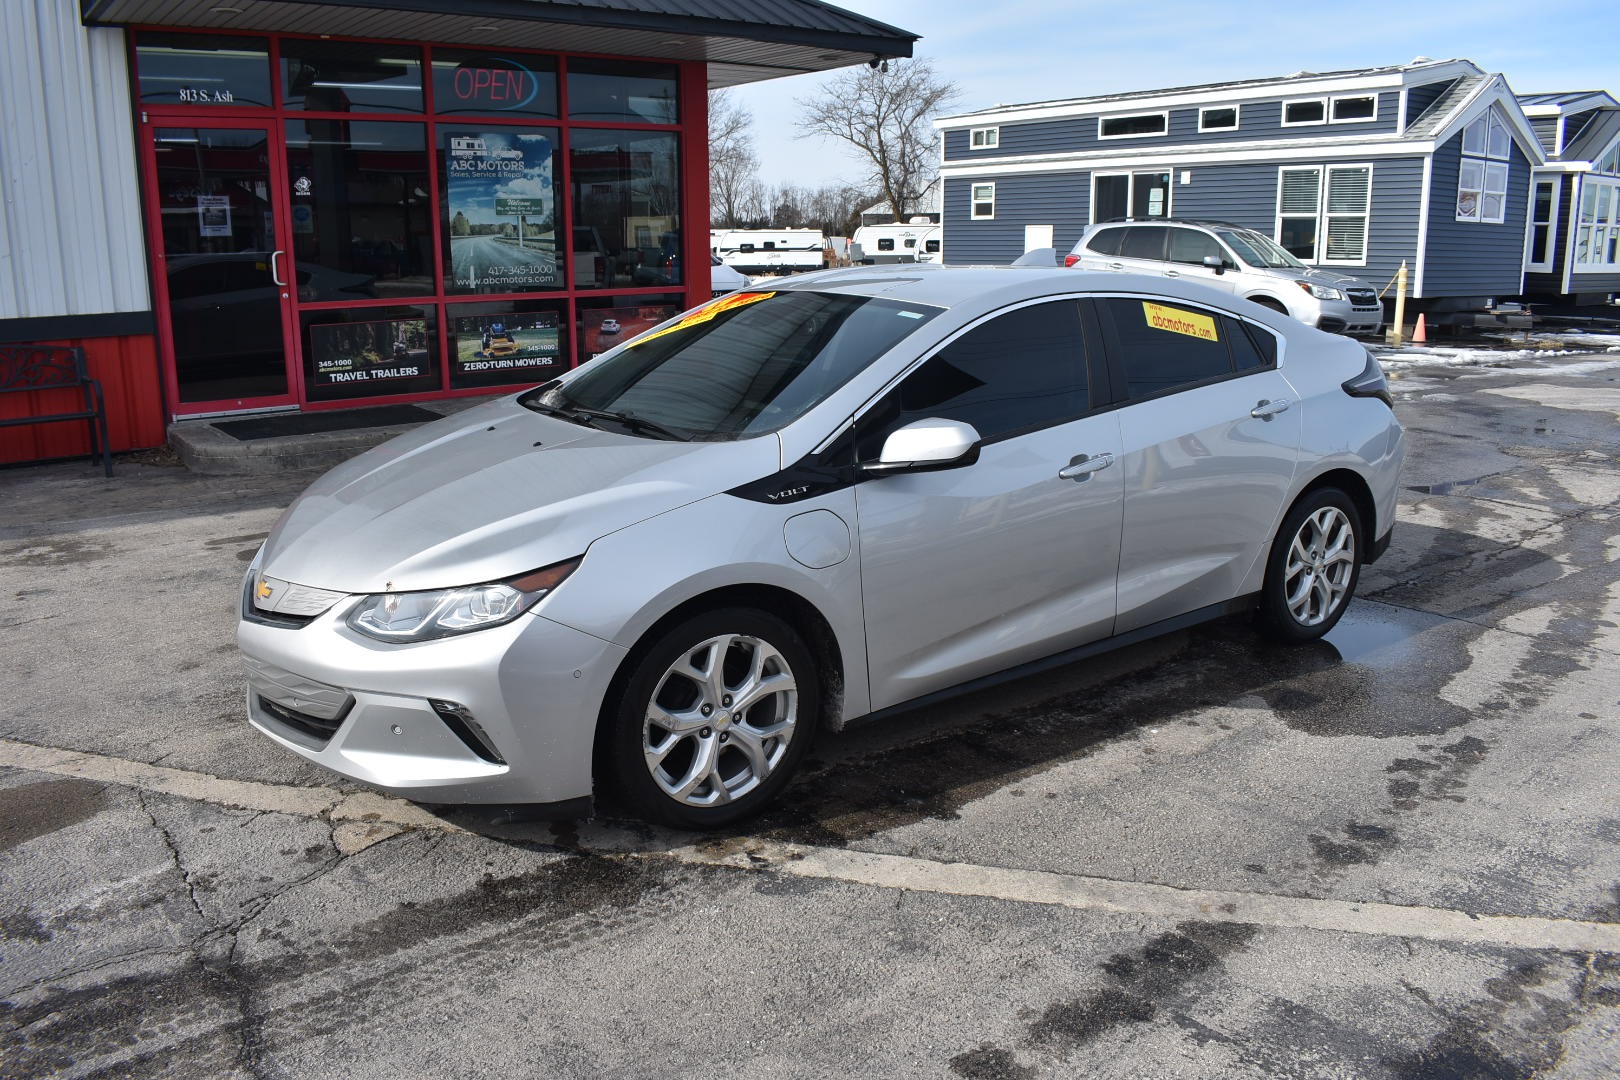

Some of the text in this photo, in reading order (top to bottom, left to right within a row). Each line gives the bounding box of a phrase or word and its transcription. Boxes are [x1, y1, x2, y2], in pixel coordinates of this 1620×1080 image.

[454, 68, 523, 100] OPEN
[179, 89, 233, 102] 813 S. Ash
[450, 161, 525, 171] ABC MOTORS
[488, 265, 553, 275] 417-345-1000
[456, 275, 554, 286] www.abcmotors.com
[527, 344, 555, 352] 345-1000
[318, 359, 352, 367] 345-1000
[463, 357, 553, 371] ZERO-TURN MOWERS
[329, 366, 419, 383] TRAVEL TRAILERS
[767, 485, 810, 500] VOLT
